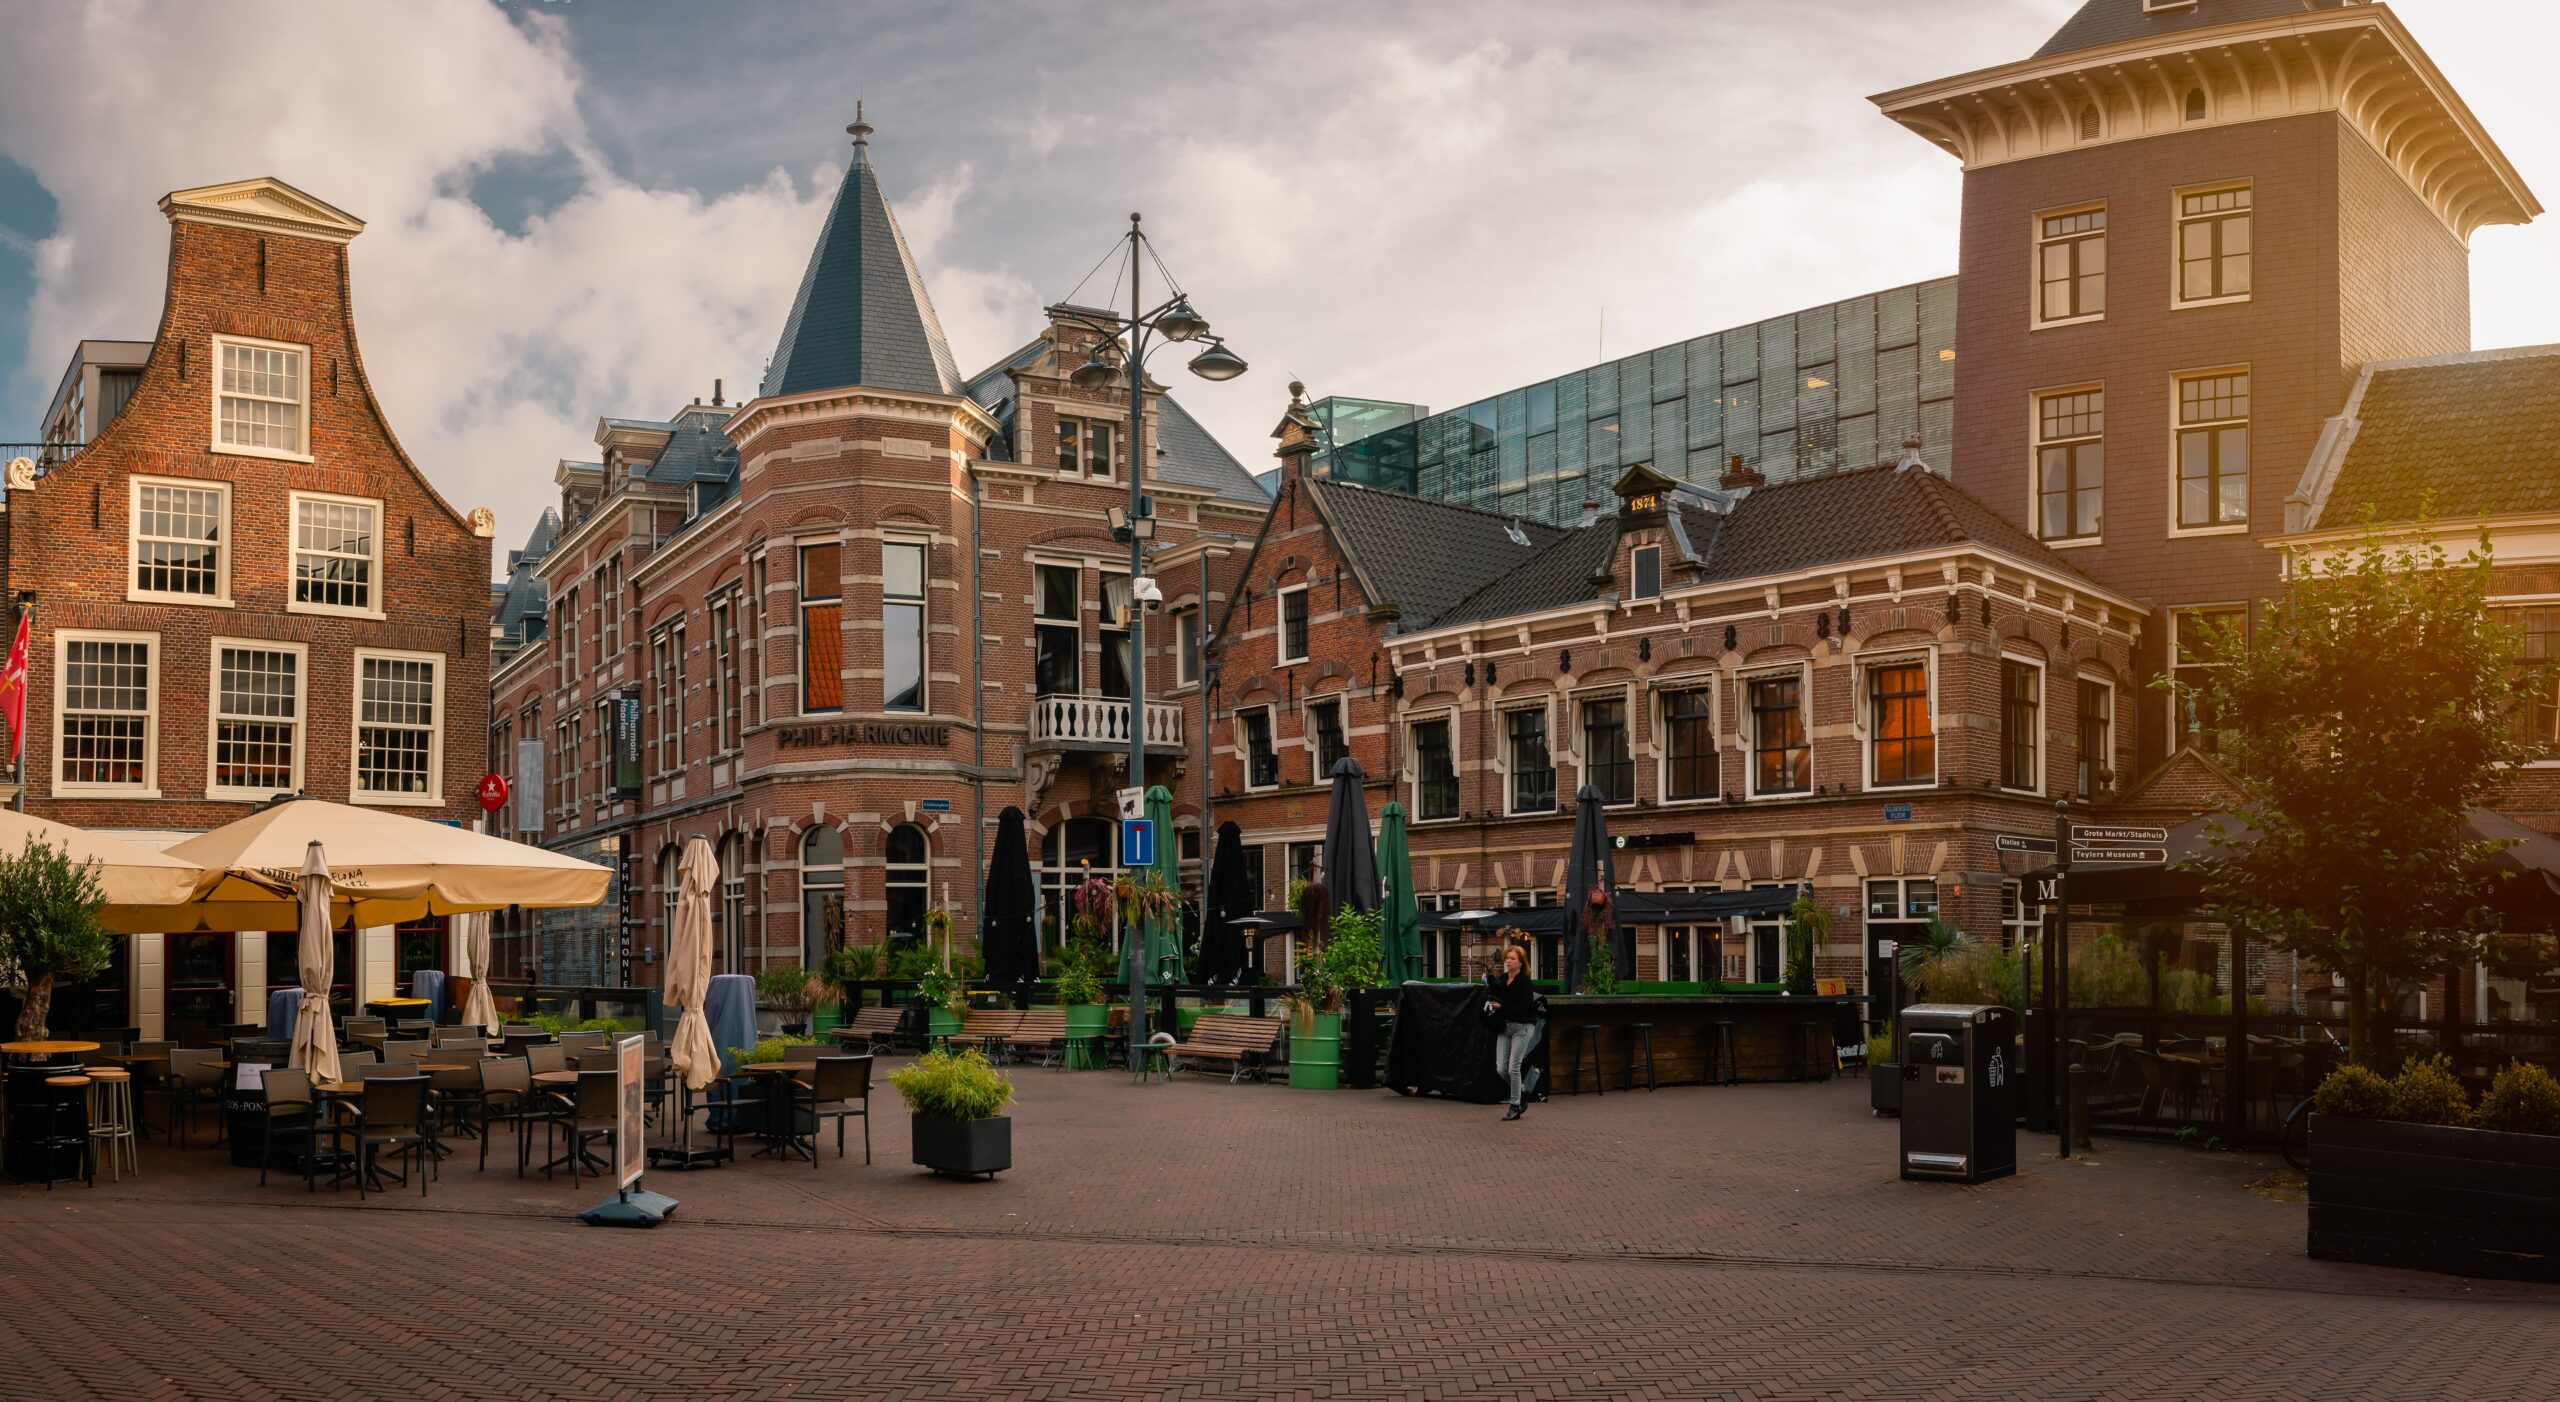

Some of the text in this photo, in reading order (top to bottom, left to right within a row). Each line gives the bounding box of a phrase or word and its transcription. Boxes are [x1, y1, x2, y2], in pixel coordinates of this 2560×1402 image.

[620, 699, 628, 740] Haarlem
[630, 699, 639, 762] Philharmonie
[778, 723, 949, 748] PHILHARMONIE
[2001, 838, 2020, 846] Station
[2105, 830, 2163, 839] Markt/Stadhuis
[2076, 851, 2104, 859] Teylers
[330, 868, 363, 882] ELONA
[621, 862, 630, 988] PHILHARMONIE
